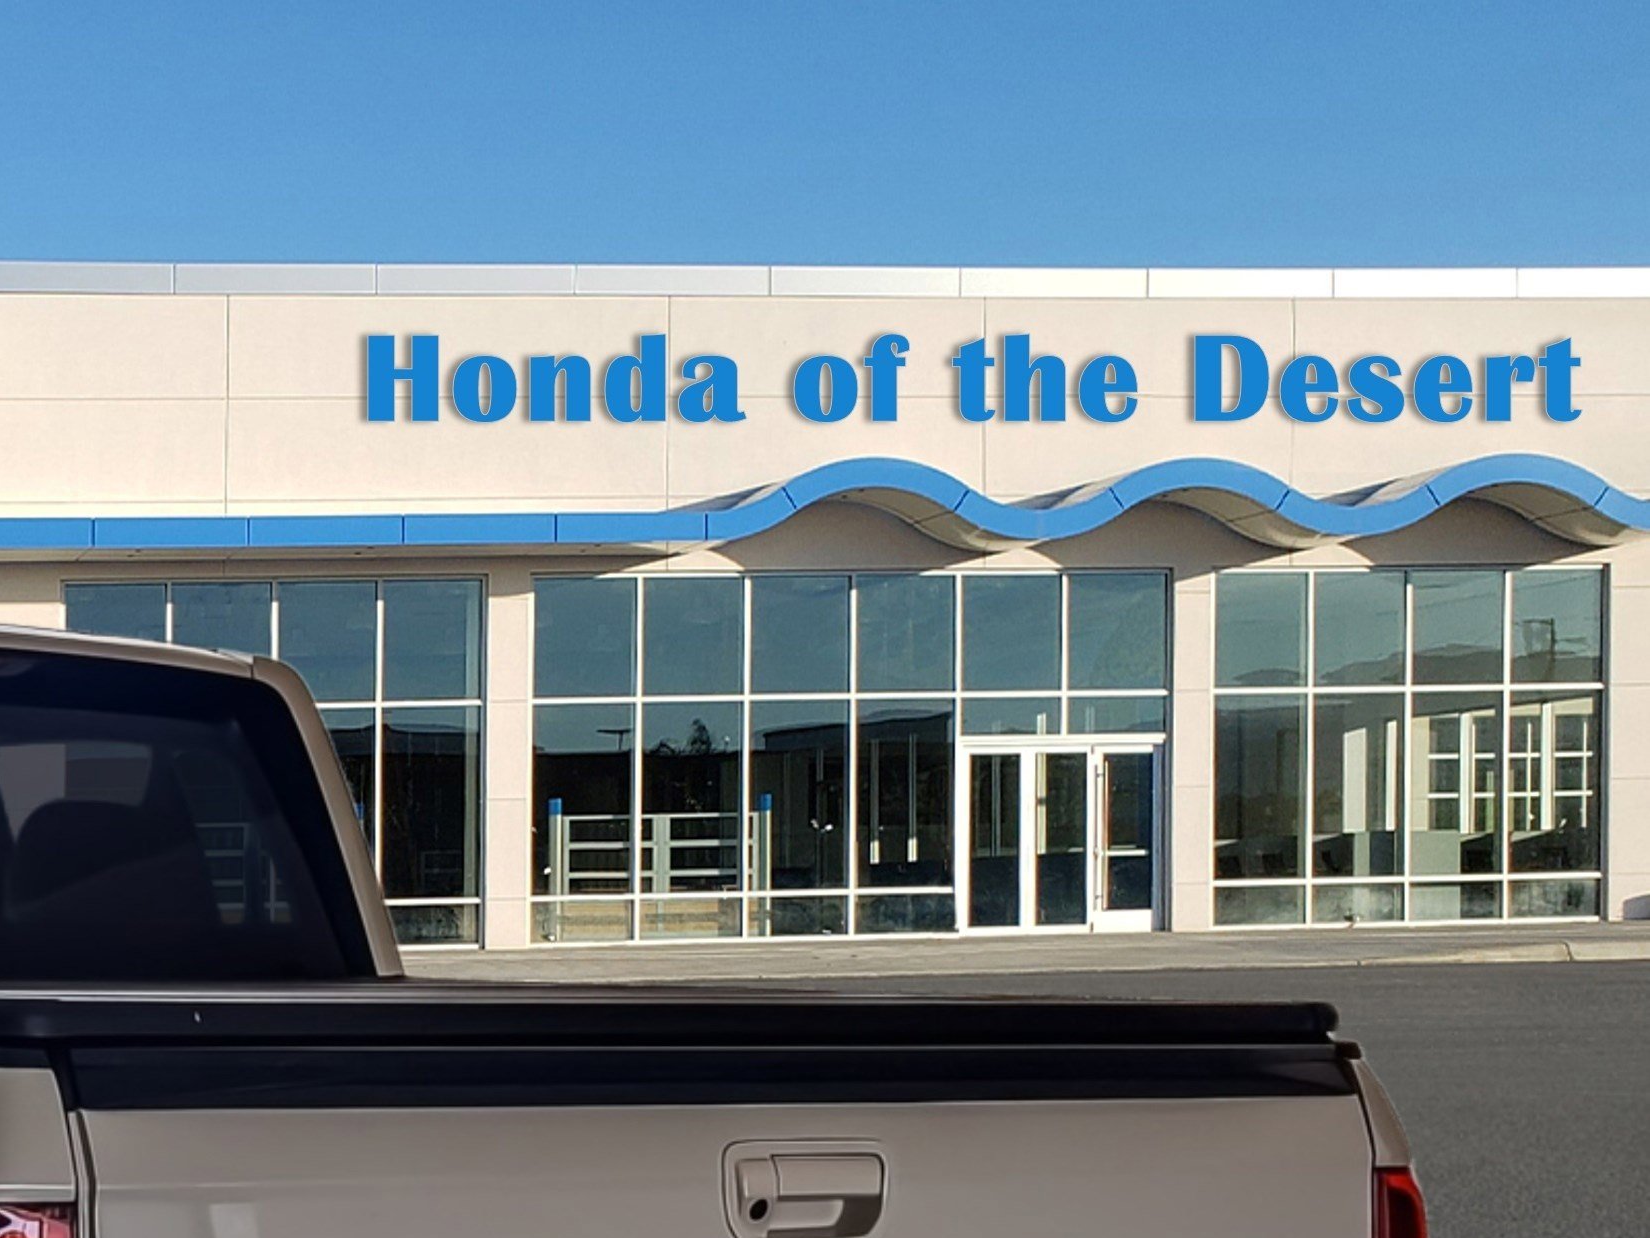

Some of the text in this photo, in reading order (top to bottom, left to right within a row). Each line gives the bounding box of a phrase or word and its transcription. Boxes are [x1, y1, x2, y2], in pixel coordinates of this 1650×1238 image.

[366, 332, 1582, 424] Honda of the Desert
